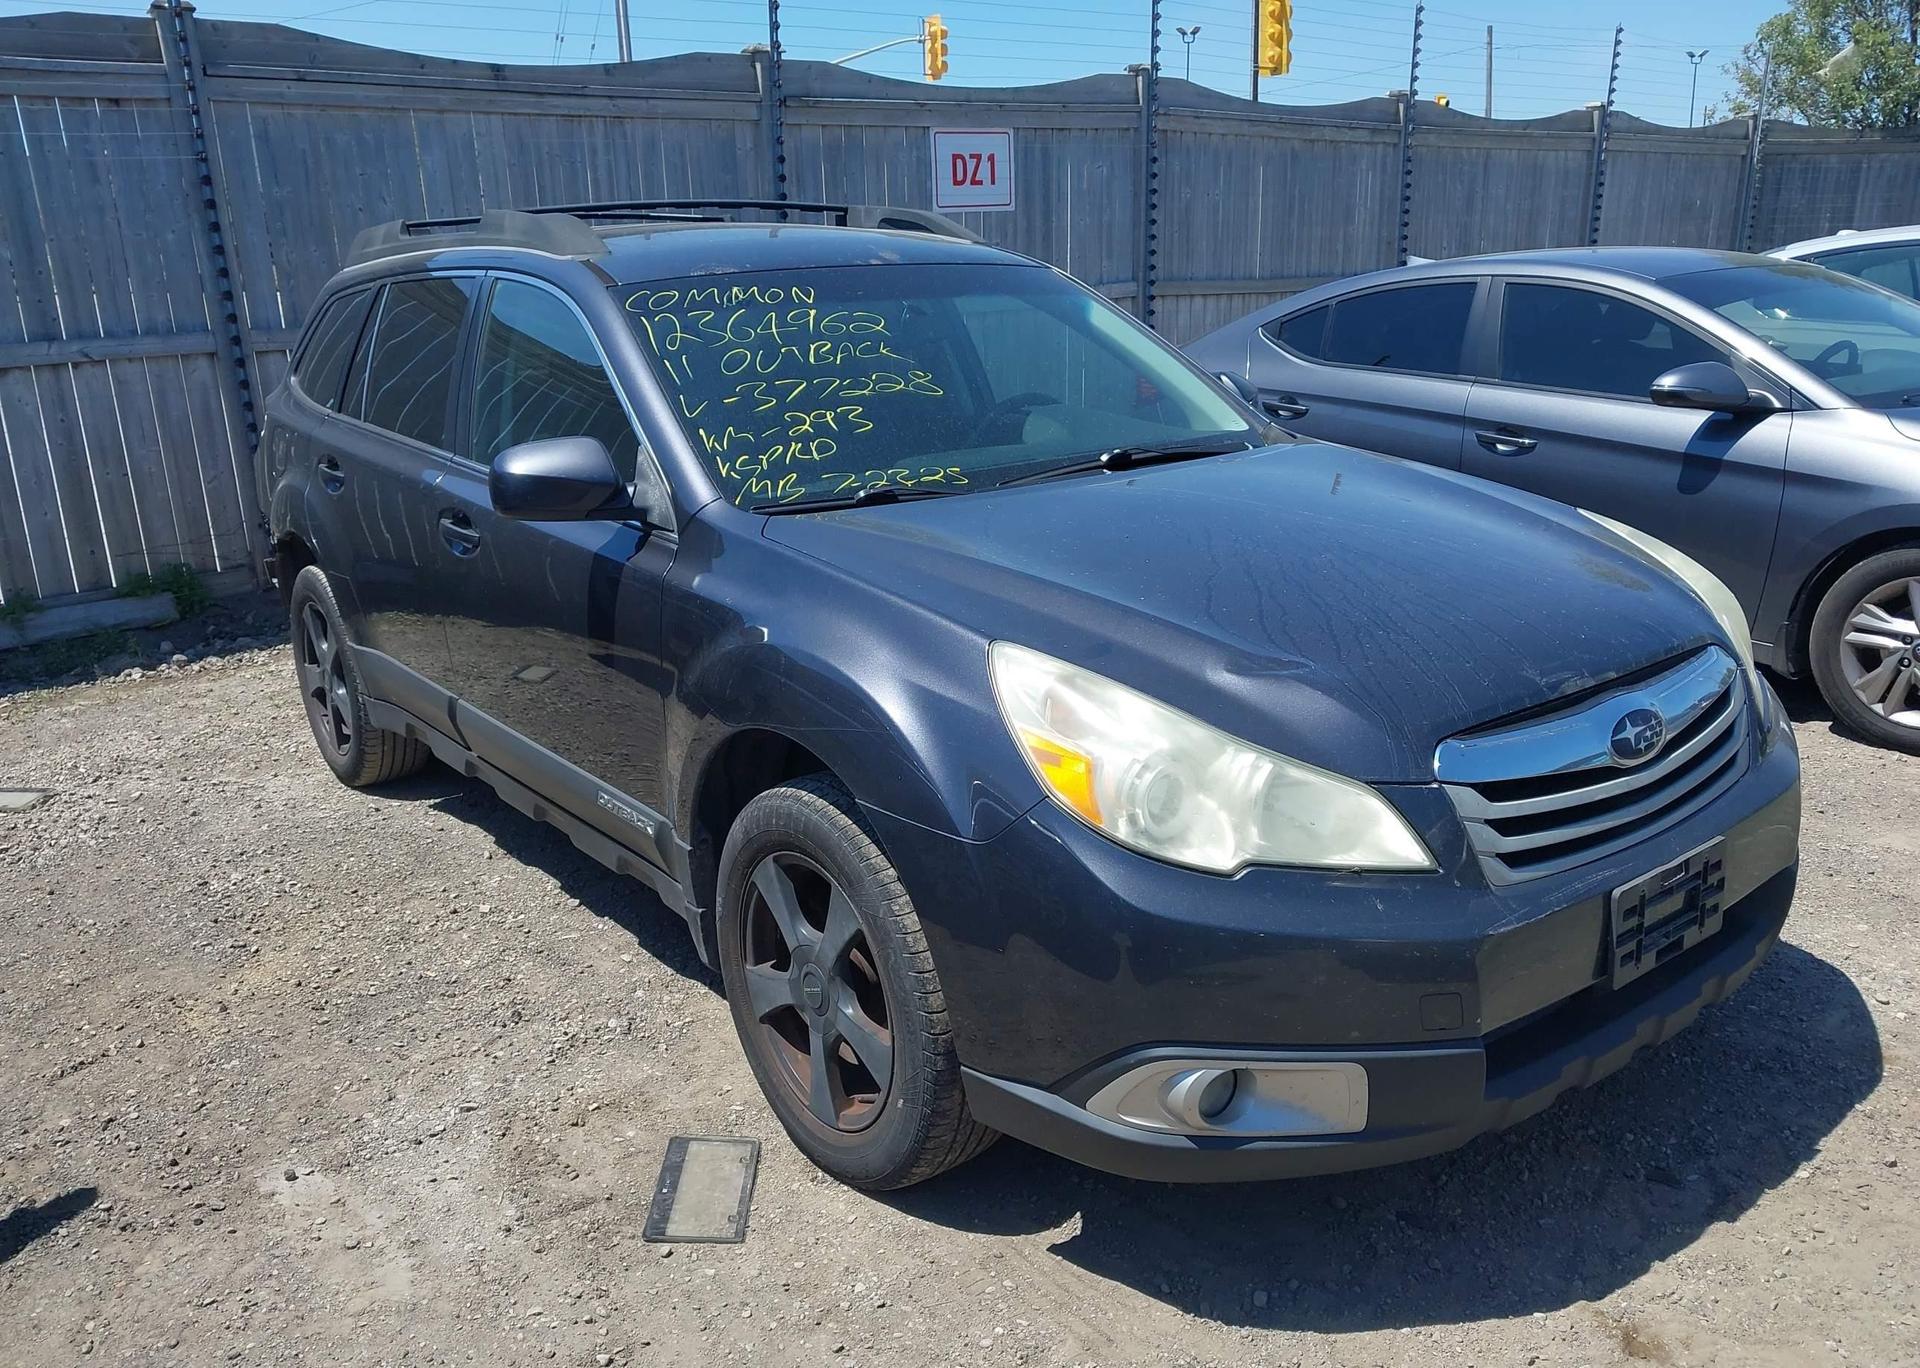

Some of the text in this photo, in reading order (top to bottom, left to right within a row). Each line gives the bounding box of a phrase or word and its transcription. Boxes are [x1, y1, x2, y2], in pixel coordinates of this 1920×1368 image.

[951, 152, 997, 187] DZ1
[625, 286, 815, 313] COMMON
[640, 308, 892, 356] 12364962
[720, 340, 916, 375] OUTBACK
